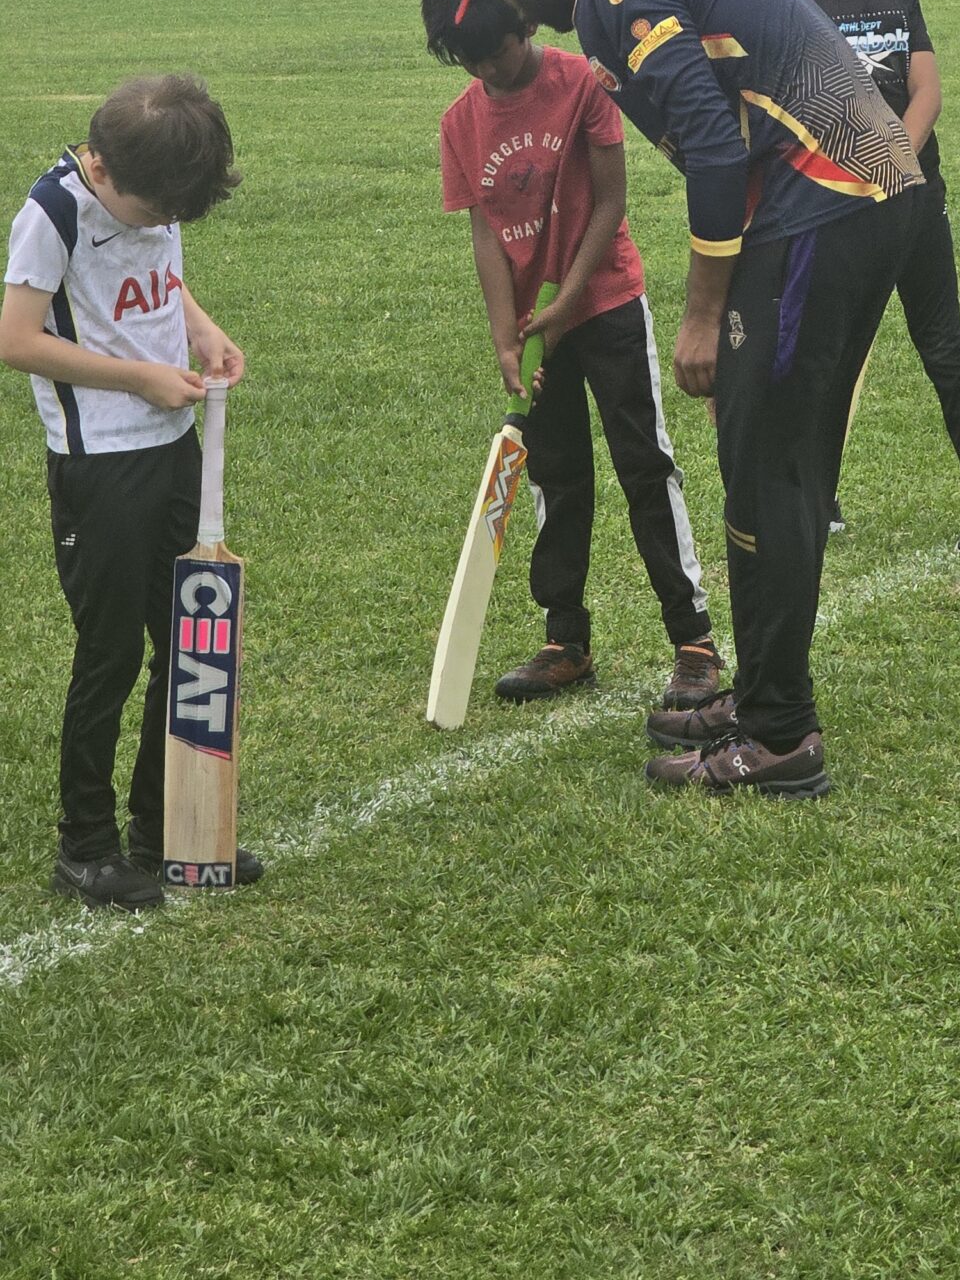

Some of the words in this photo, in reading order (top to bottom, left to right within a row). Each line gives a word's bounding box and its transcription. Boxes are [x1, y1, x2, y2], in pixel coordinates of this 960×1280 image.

[629, 46, 645, 69] SRI
[481, 132, 533, 187] BURGER
[542, 132, 563, 152] RU
[114, 261, 182, 321] AIA
[176, 571, 232, 732] CEAT
[167, 864, 230, 884] CEAT
